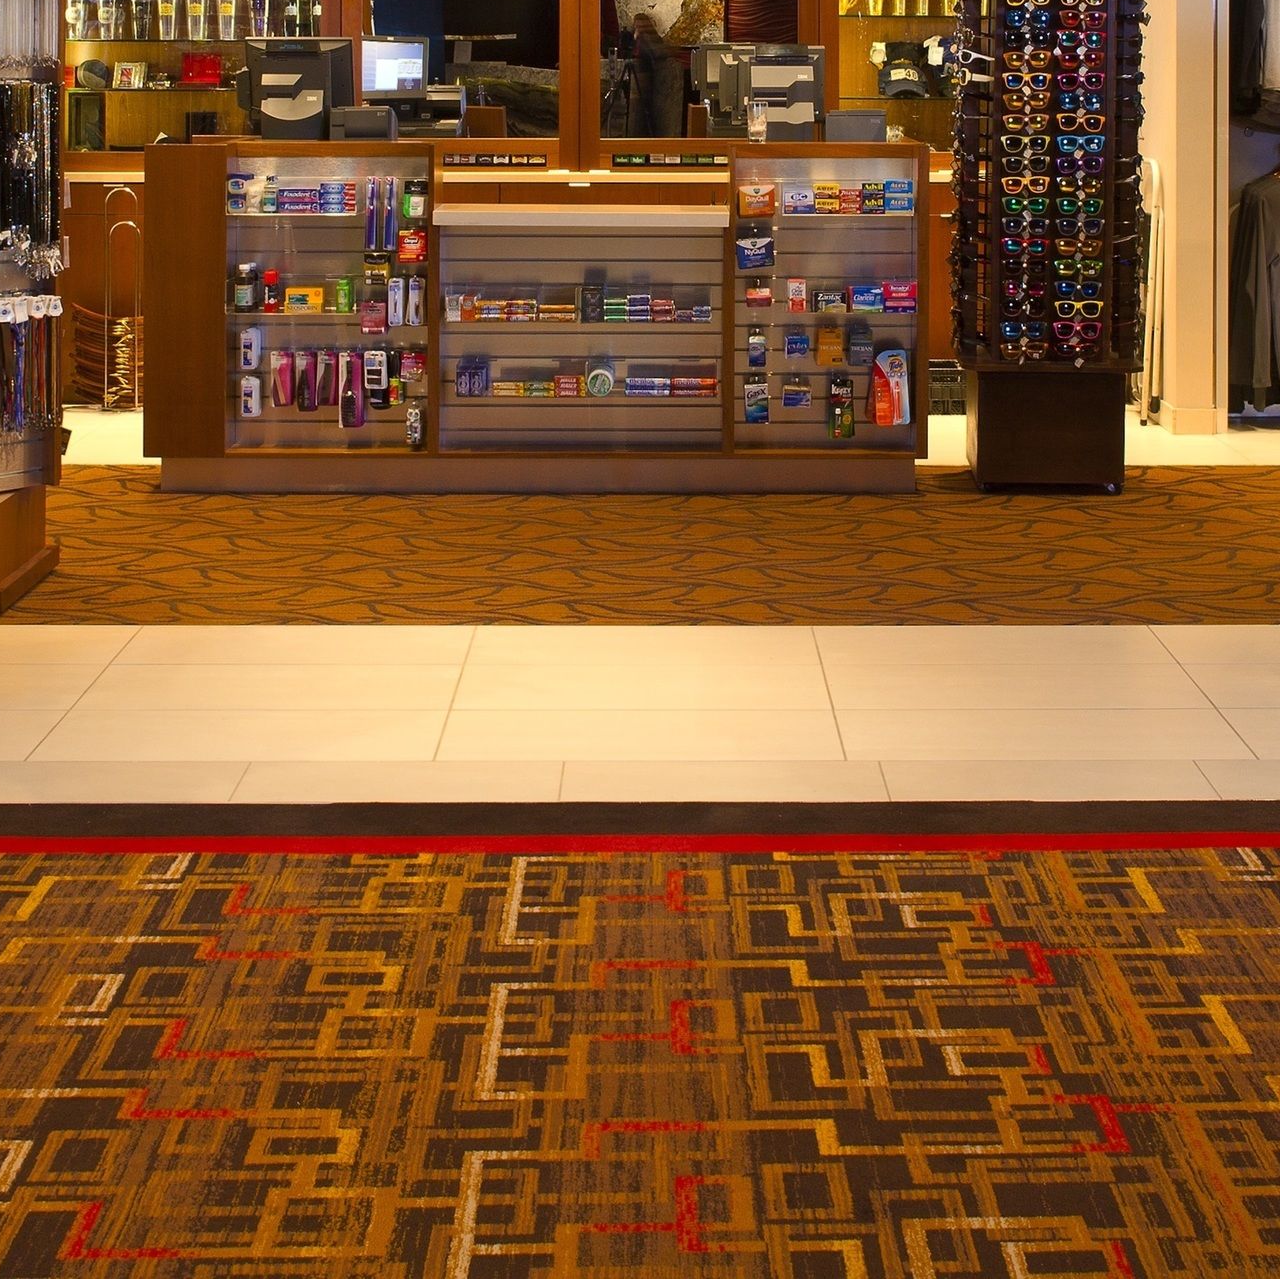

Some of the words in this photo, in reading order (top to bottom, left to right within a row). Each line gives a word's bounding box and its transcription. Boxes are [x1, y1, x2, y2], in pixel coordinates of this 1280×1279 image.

[864, 183, 883, 191] Advil
[745, 195, 769, 203] DayQuil
[744, 247, 766, 257] NyQuil
[818, 293, 841, 301] Zantac
